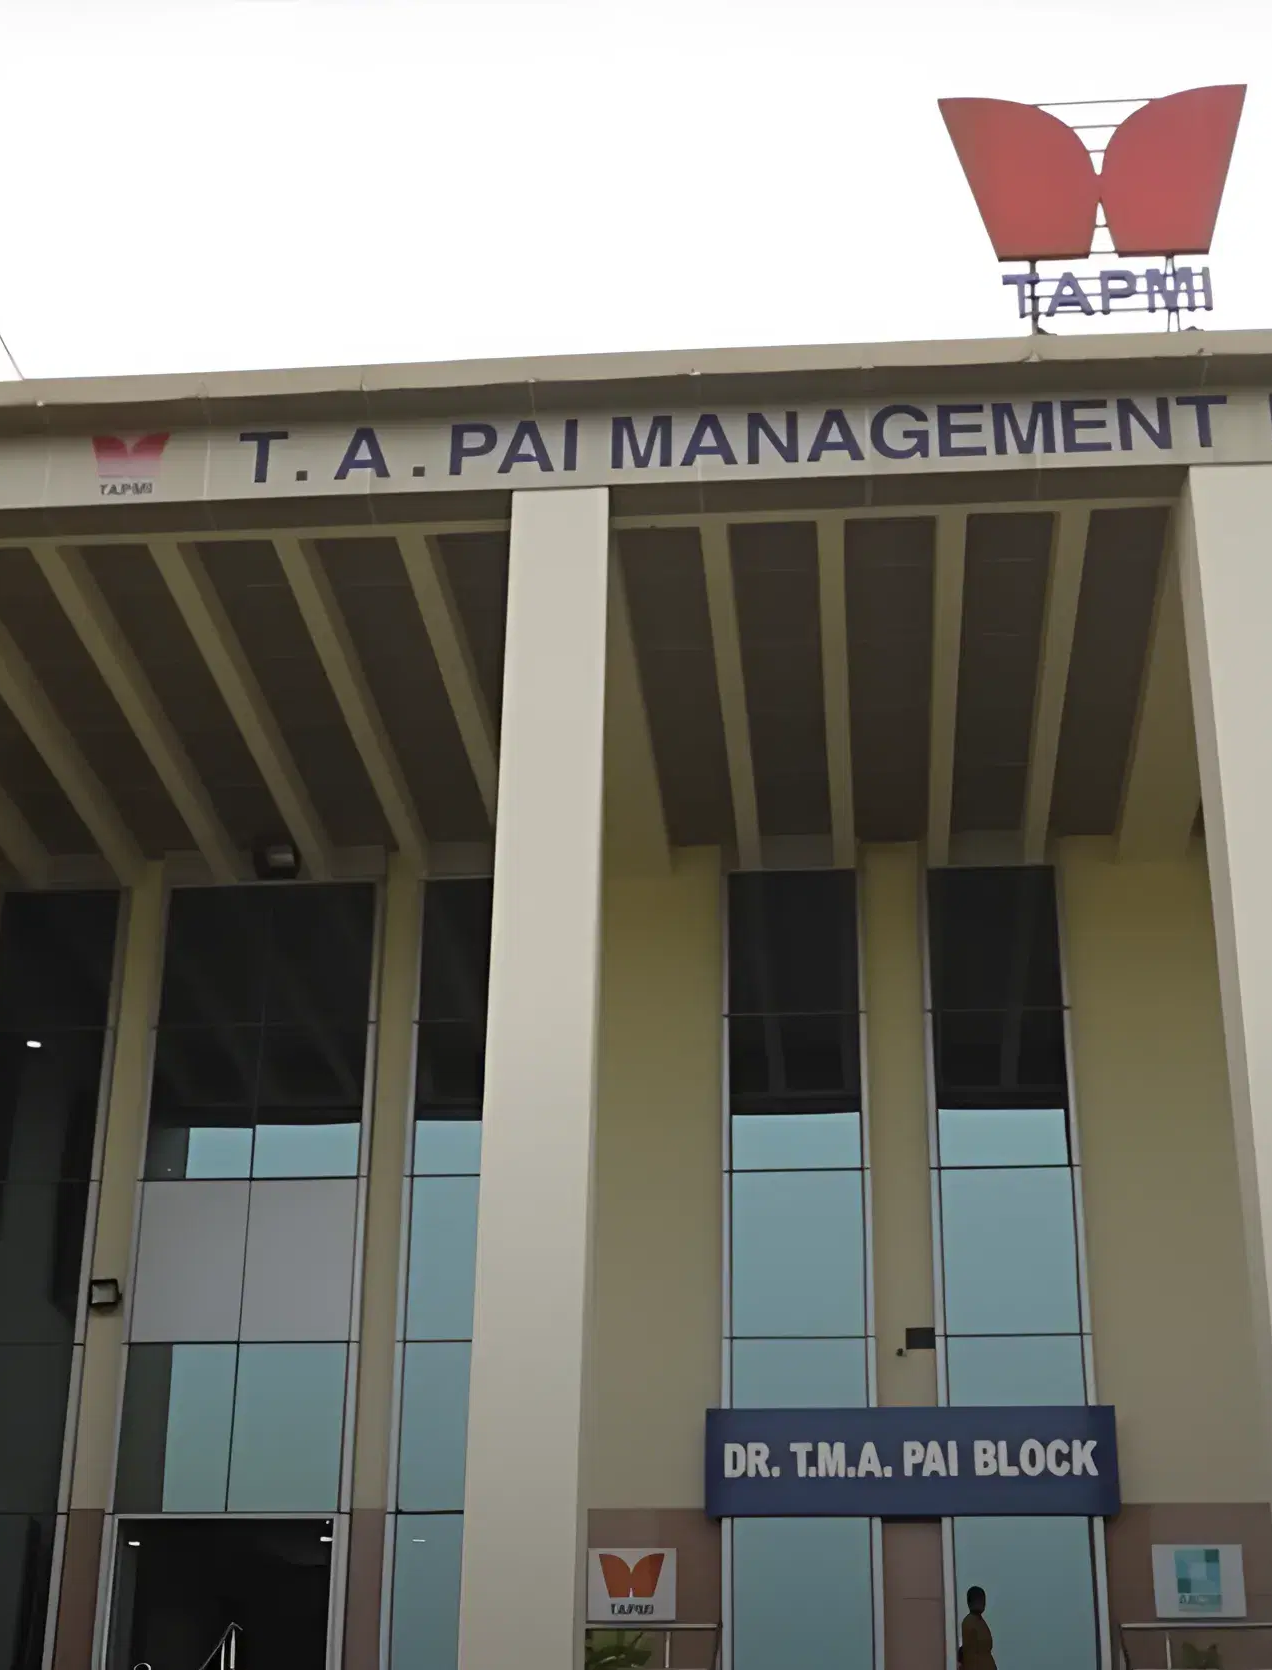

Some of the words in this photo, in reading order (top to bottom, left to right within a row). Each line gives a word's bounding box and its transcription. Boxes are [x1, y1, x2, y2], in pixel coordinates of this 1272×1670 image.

[1002, 266, 1213, 319] TAPMI
[239, 431, 309, 483] T.
[448, 418, 579, 476] PAI
[612, 394, 1228, 469] MANAGEMENT
[723, 1442, 780, 1479] DR.
[789, 1441, 893, 1478] T.M.A.
[903, 1440, 959, 1477] PAI
[973, 1438, 1099, 1476] BLOCK
